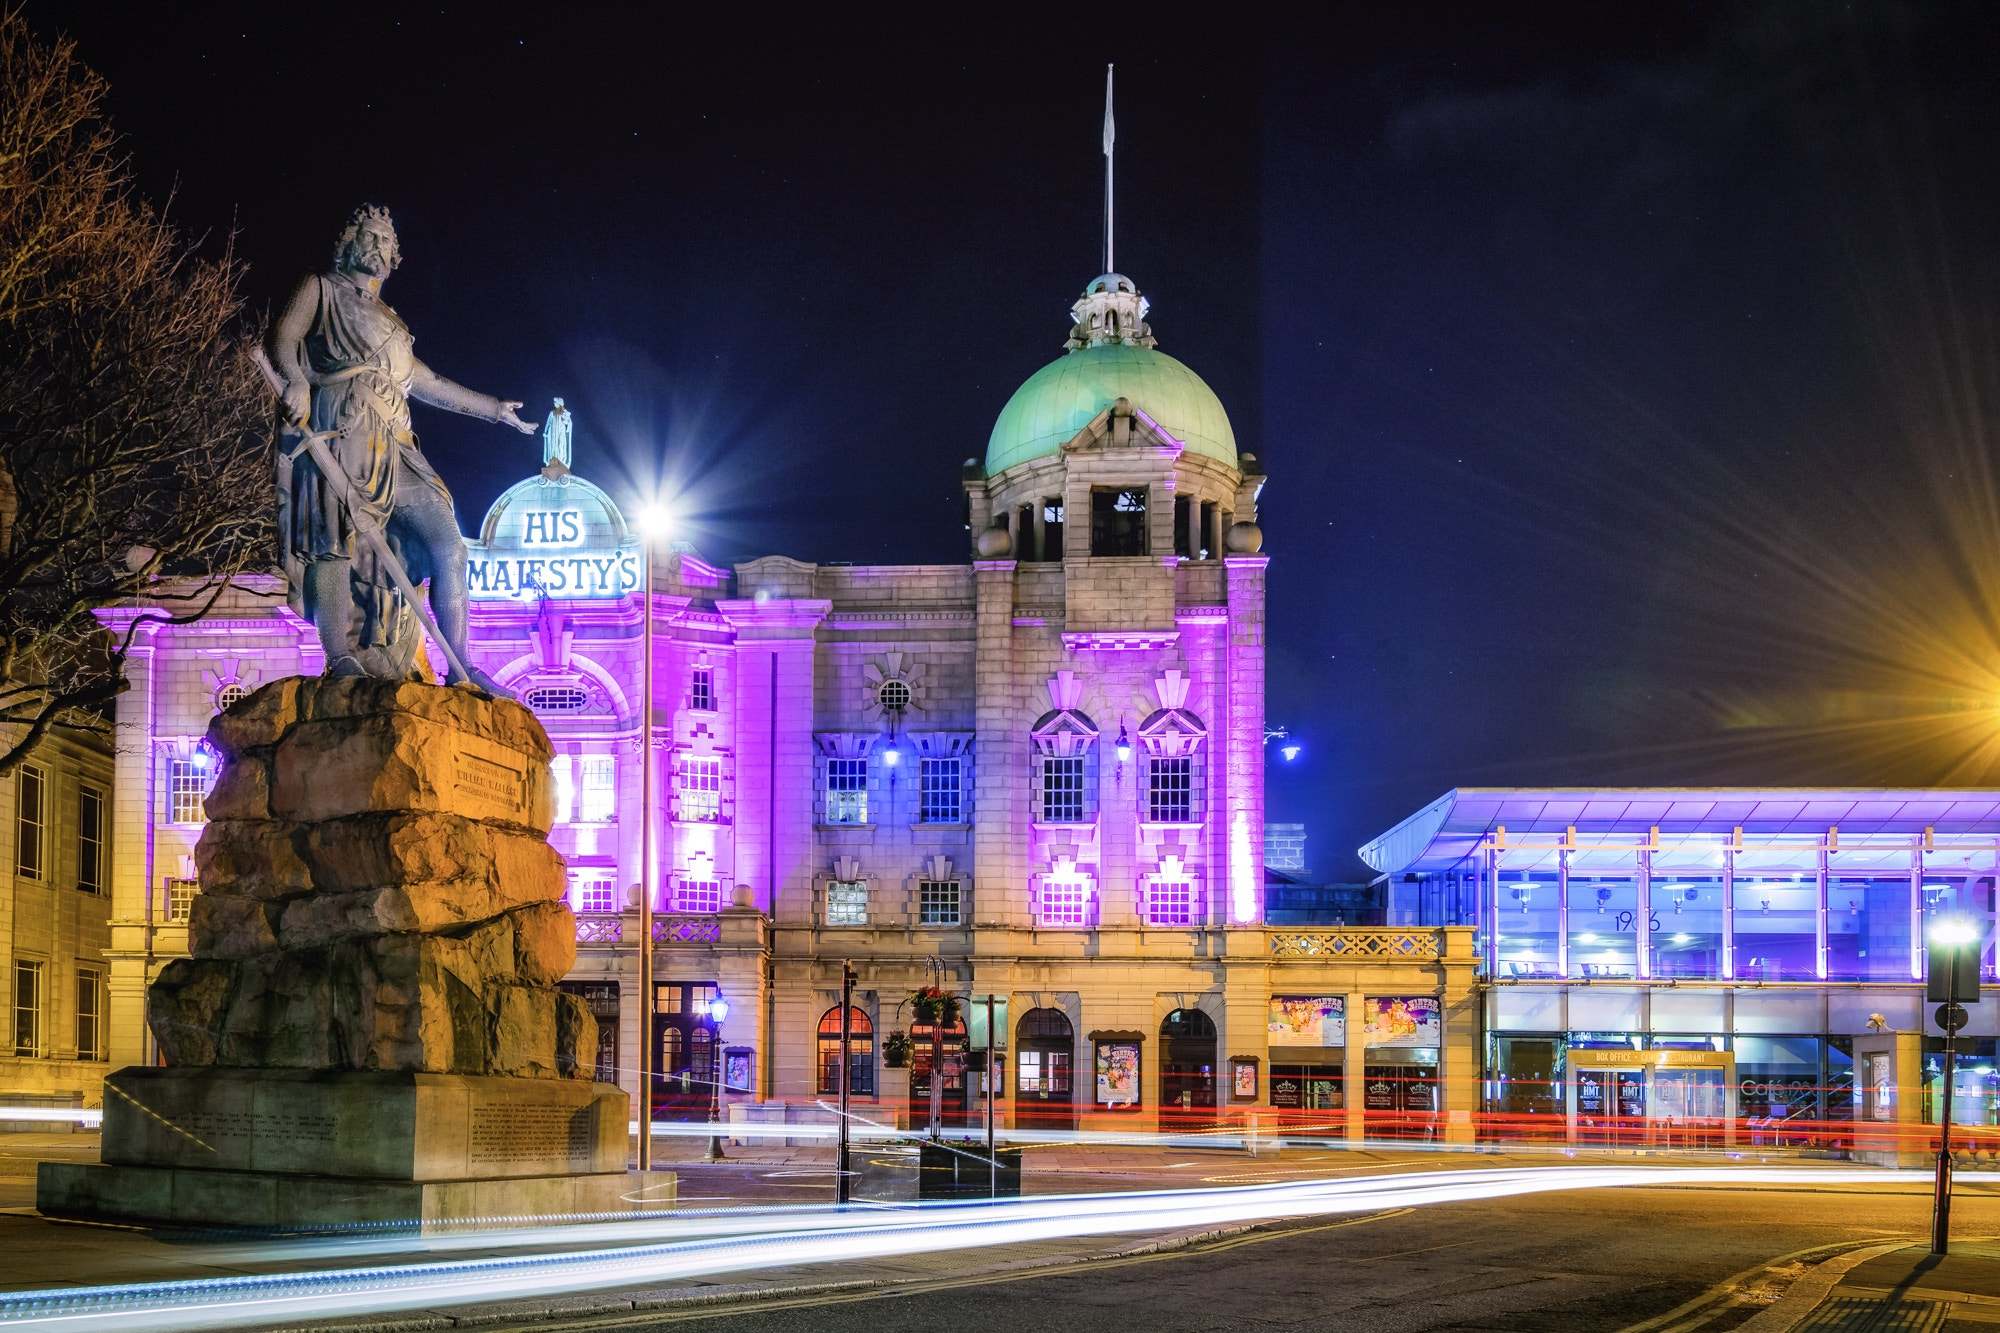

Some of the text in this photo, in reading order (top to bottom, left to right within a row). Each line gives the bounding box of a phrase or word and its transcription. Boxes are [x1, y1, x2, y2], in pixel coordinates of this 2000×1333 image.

[524, 511, 579, 543] HIS
[468, 551, 637, 597] MAJESTY'S
[1615, 911, 1660, 931] 196
[1596, 1052, 1608, 1062] BOX
[1610, 1053, 1631, 1062] OFFICE
[1583, 1085, 1600, 1097] HMT
[1622, 1086, 1639, 1097] HMT
[1741, 1079, 1785, 1096] Café
